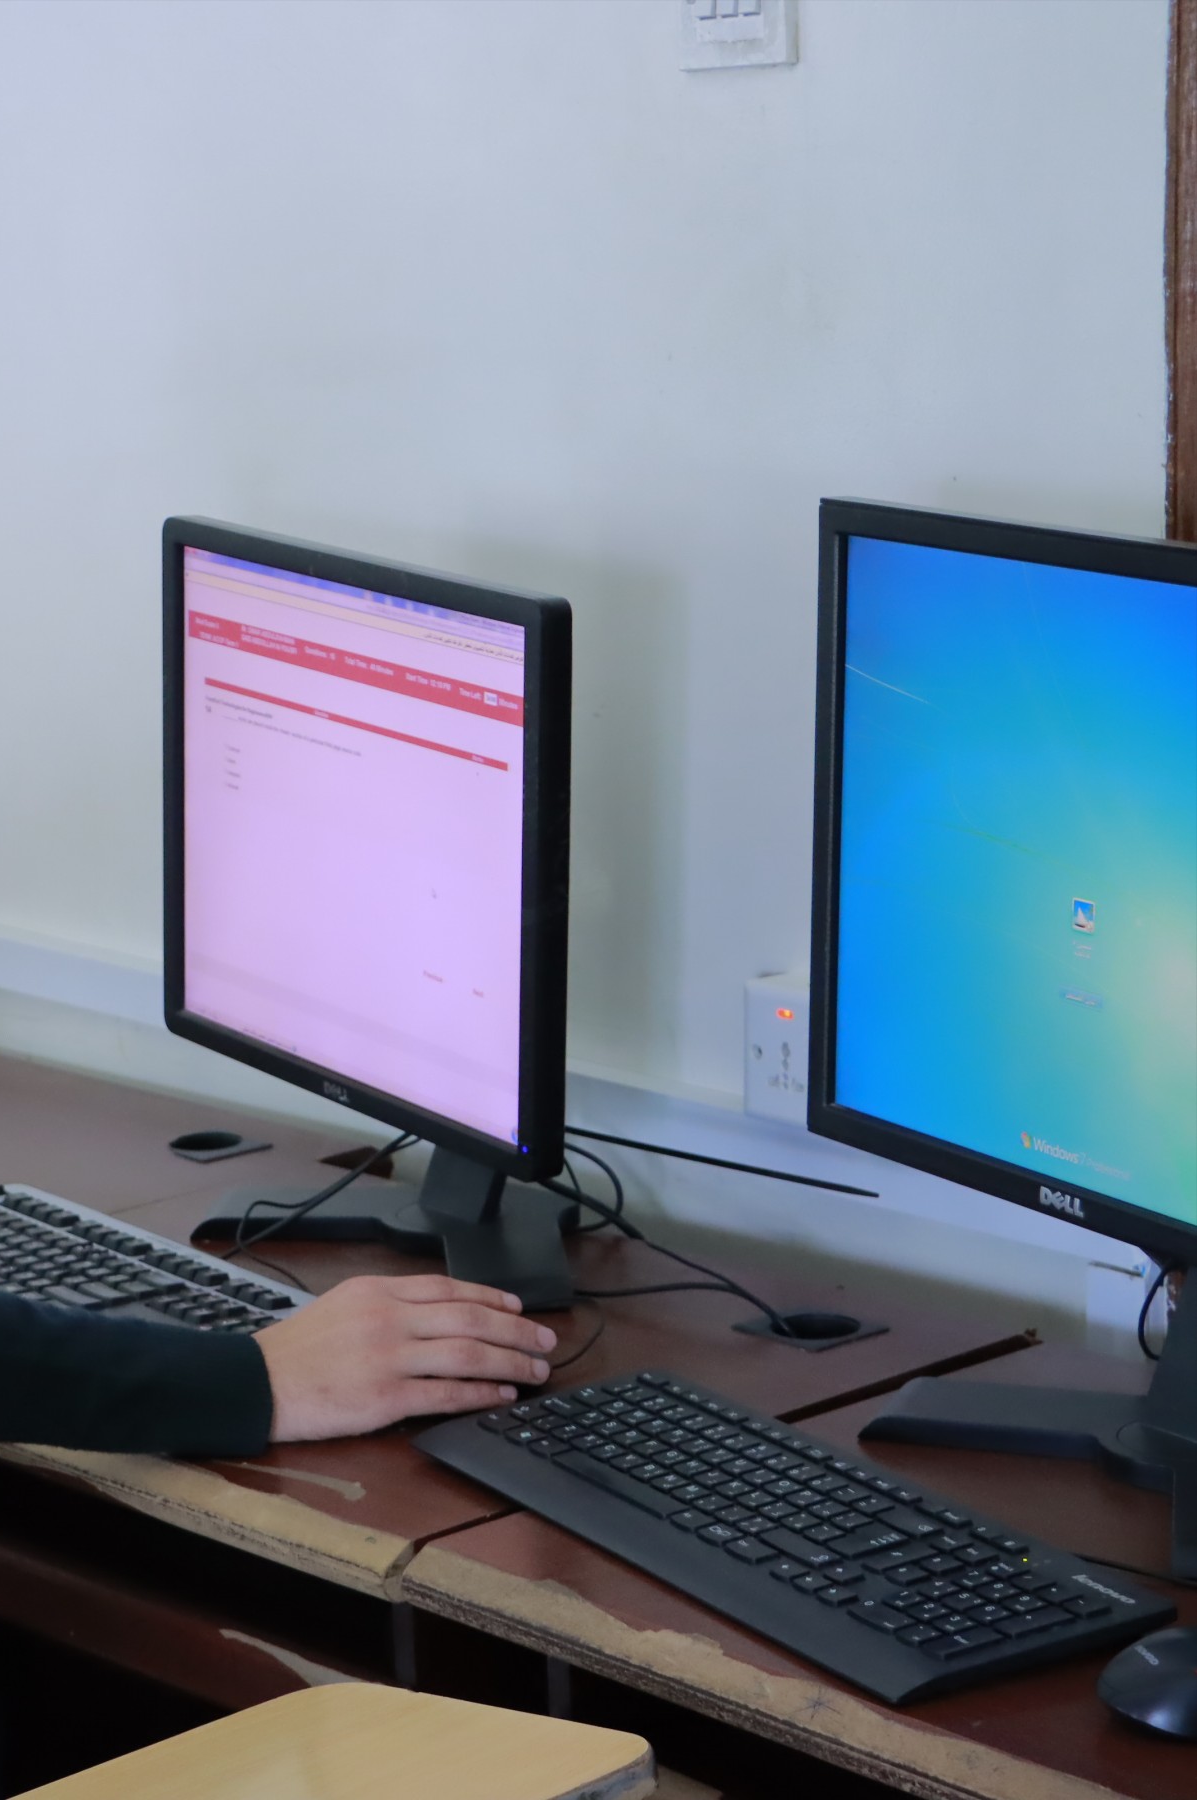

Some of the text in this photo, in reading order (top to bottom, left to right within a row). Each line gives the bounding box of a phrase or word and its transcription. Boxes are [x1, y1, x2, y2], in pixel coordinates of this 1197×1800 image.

[1033, 1137, 1080, 1164] Windows
[1039, 1186, 1086, 1219] DELL
[1071, 1574, 1136, 1604] lenovo
